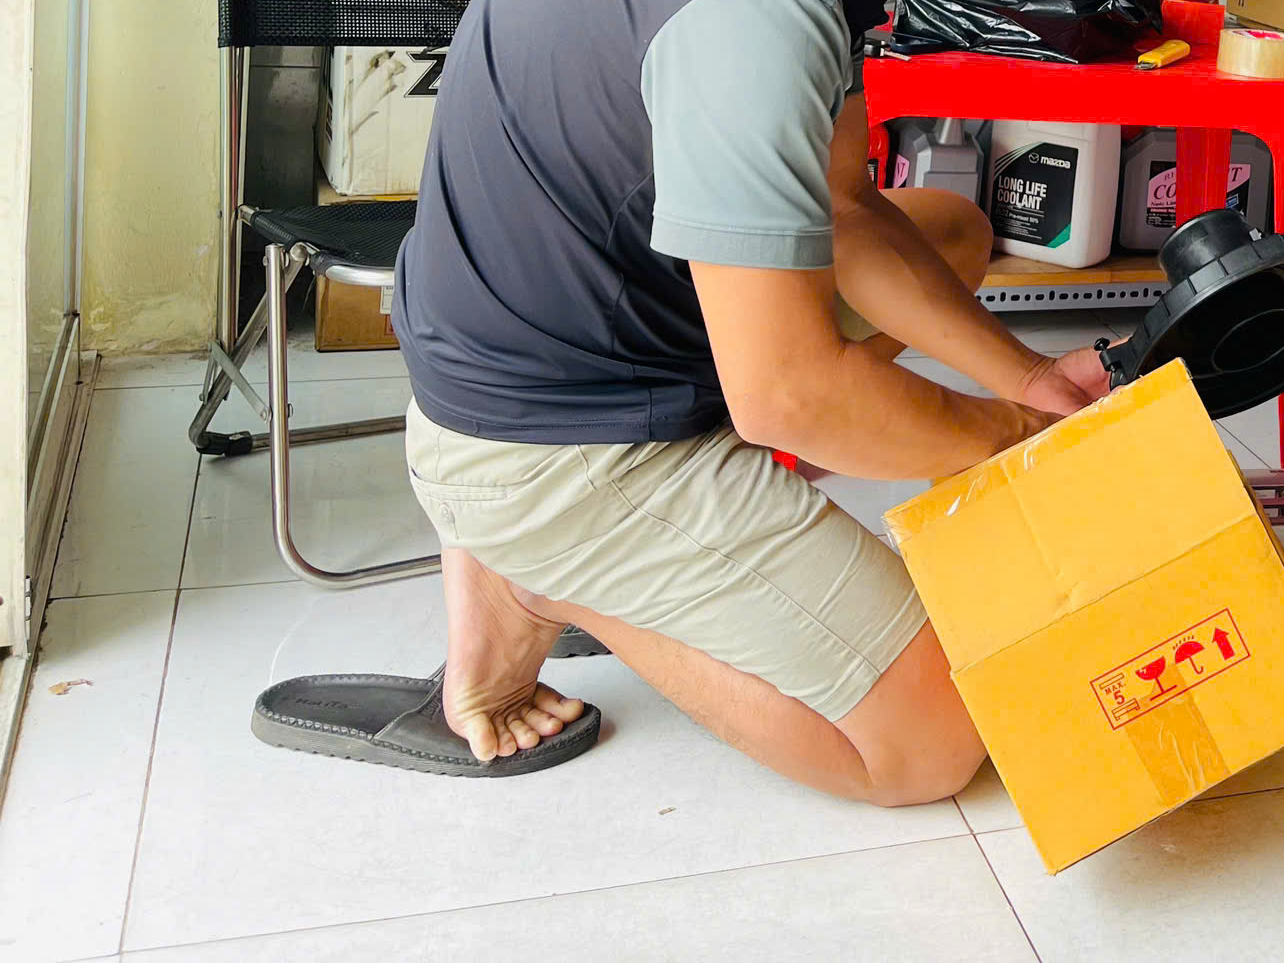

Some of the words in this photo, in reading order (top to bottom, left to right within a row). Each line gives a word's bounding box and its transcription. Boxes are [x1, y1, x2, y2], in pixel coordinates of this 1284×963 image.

[1040, 156, 1071, 170] mazda
[998, 175, 1024, 192] LONG
[1025, 180, 1047, 198] LIFE
[997, 189, 1042, 210] COOLANT
[1114, 689, 1125, 705] 5
